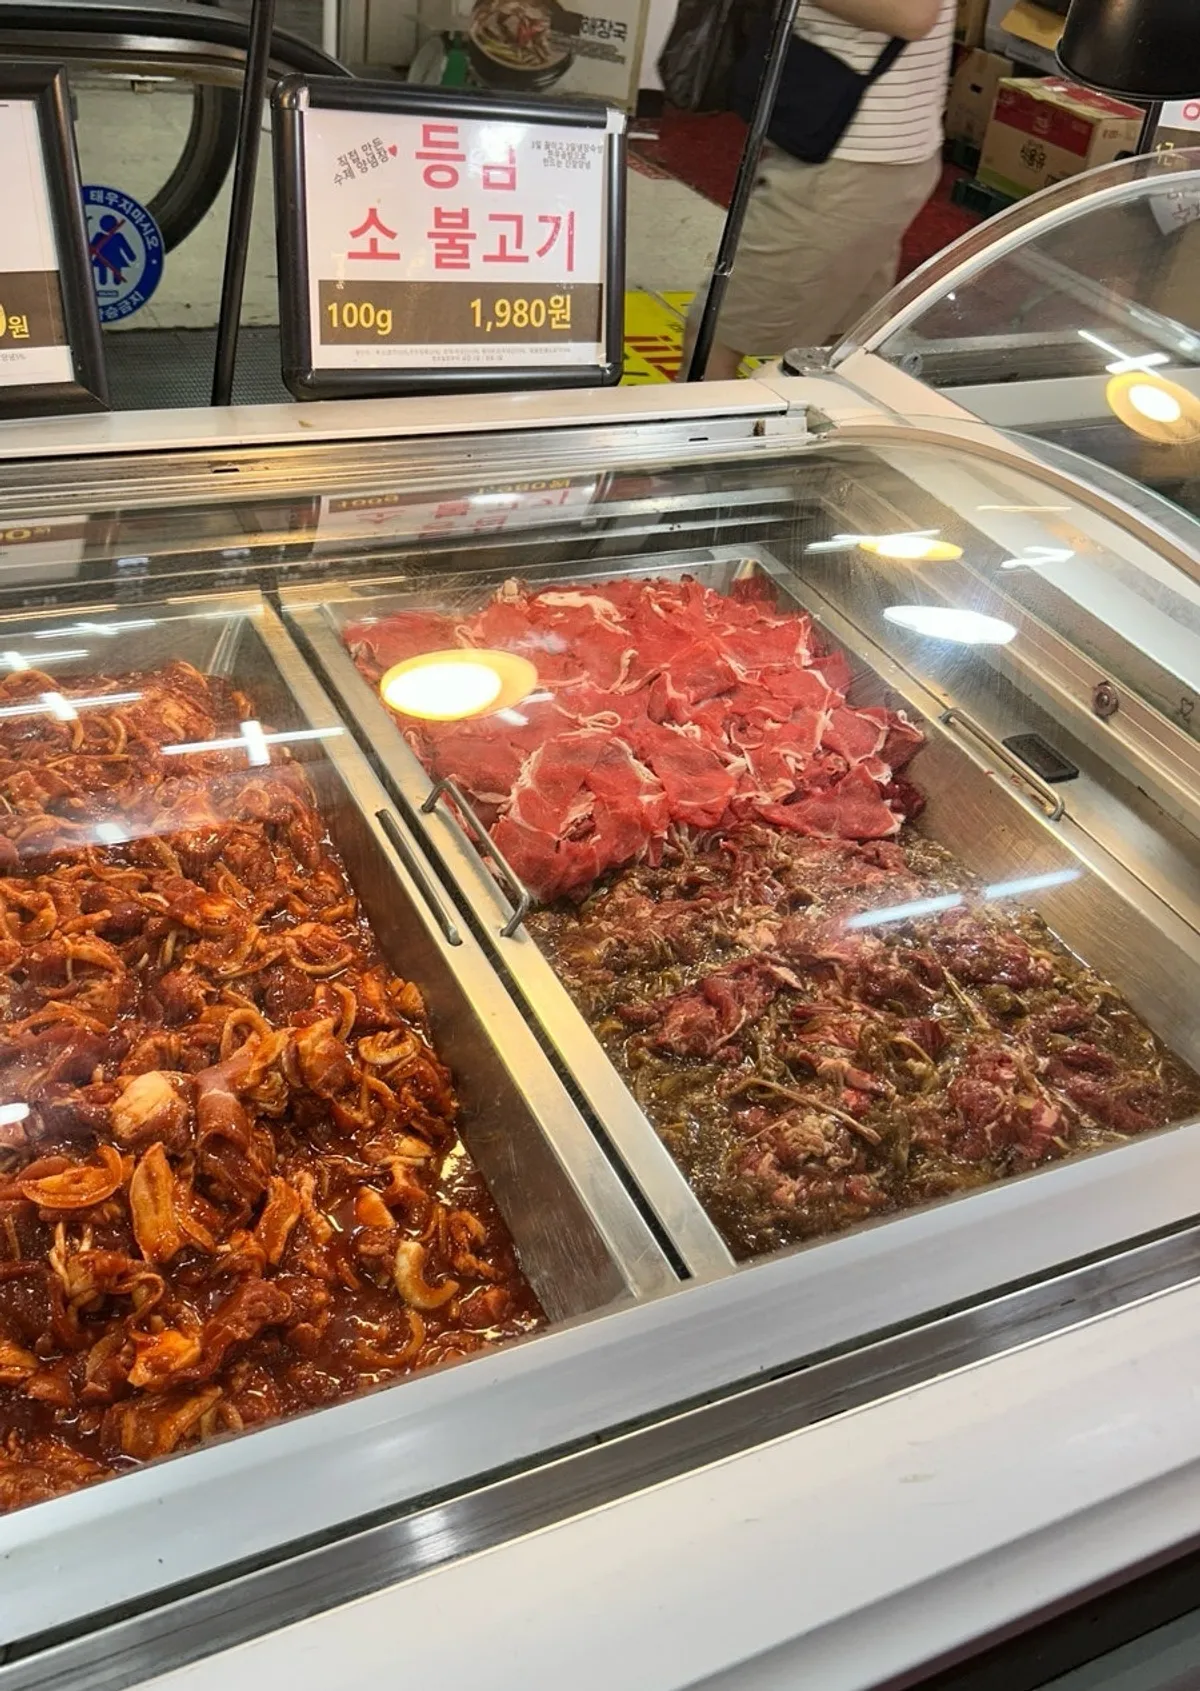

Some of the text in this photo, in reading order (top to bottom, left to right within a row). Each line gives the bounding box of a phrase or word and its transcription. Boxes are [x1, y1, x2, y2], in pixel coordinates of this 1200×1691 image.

[89, 189, 160, 251] 태우지마시오
[348, 207, 575, 272] 소 불고기
[99, 290, 145, 321] 승금지
[328, 303, 393, 335] 100g
[470, 294, 572, 332] 1,980원
